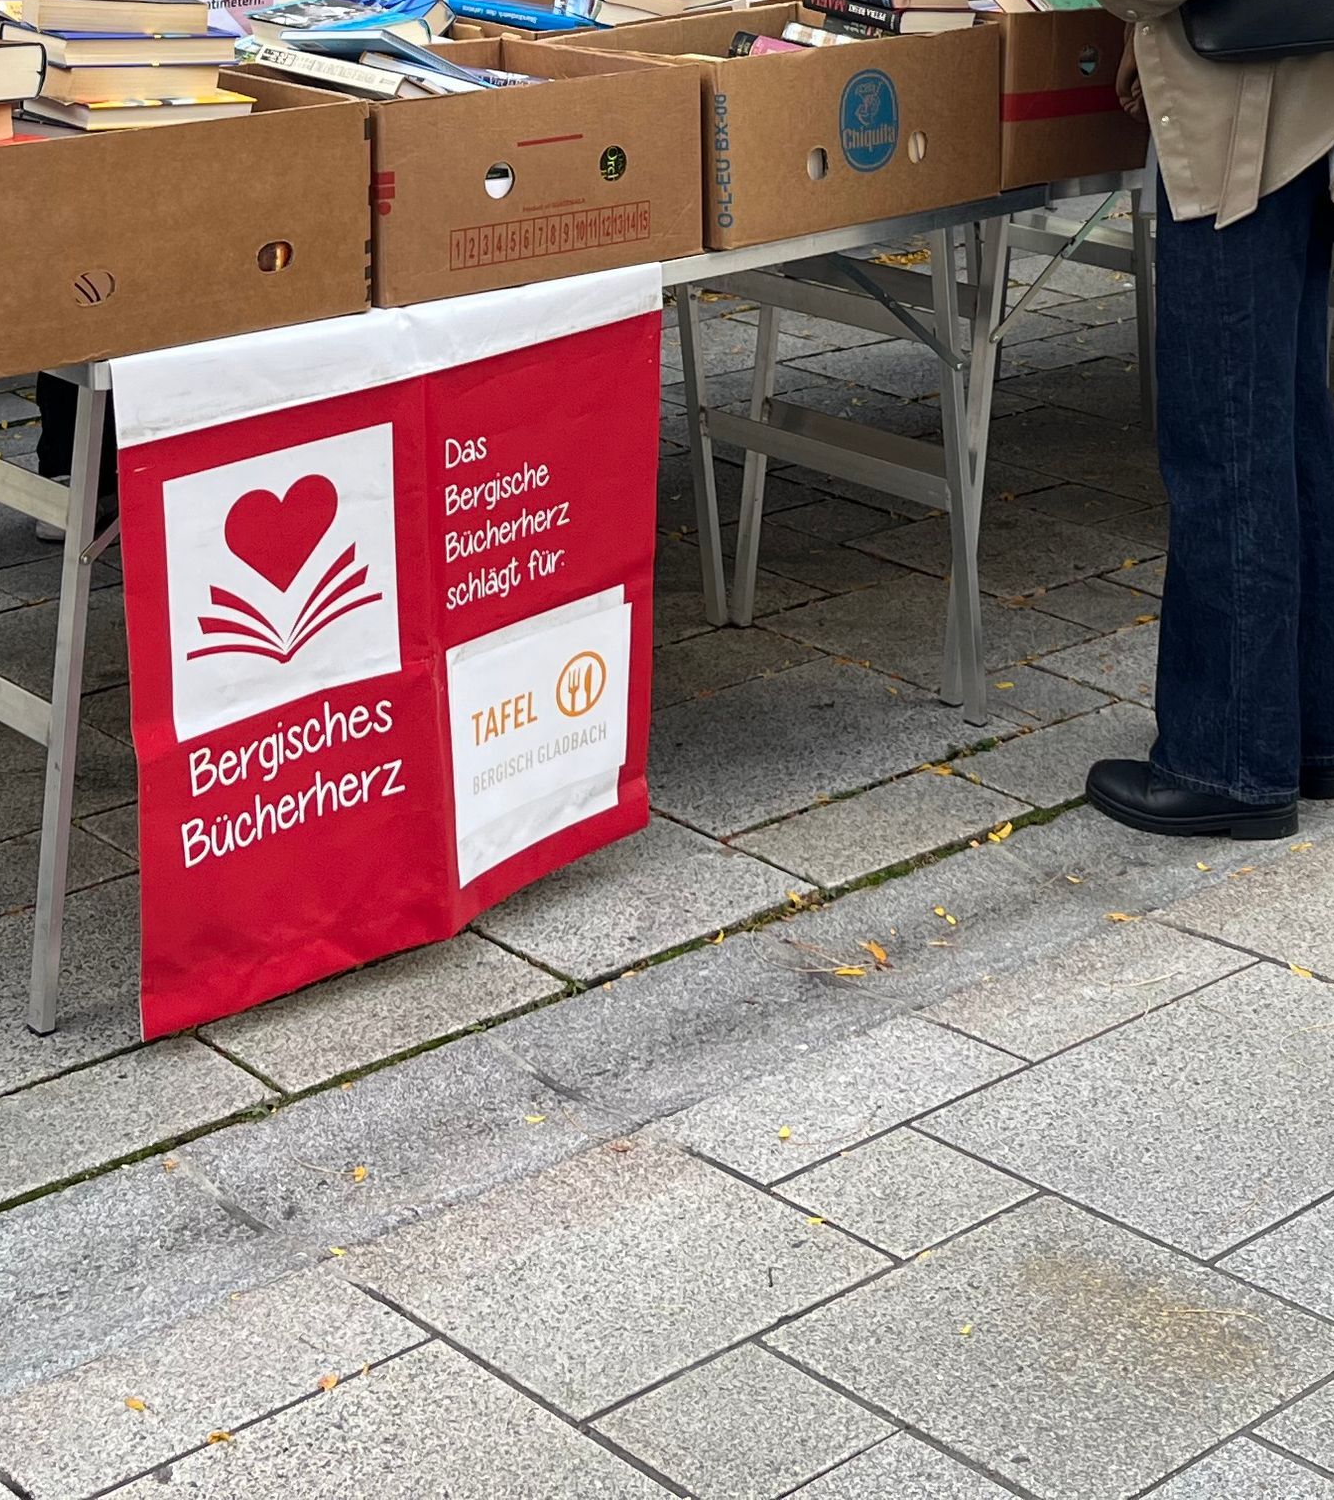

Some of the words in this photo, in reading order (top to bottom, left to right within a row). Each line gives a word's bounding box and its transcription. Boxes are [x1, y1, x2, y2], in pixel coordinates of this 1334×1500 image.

[714, 92, 731, 152] BX-06
[842, 123, 897, 153] Chiquita
[716, 158, 734, 229] O-L-EU
[455, 239, 461, 261] 1
[468, 237, 476, 260] 2
[482, 235, 490, 257] 3
[495, 233, 503, 255] 4
[509, 230, 517, 253] 5
[523, 228, 530, 250] 6
[537, 226, 544, 248] 7
[550, 224, 557, 246] 8
[563, 222, 570, 244] 9
[575, 219, 586, 242] 10
[588, 217, 598, 239] 11
[601, 215, 611, 238] 12
[614, 213, 625, 236] 13
[626, 211, 637, 234] 14
[638, 209, 649, 232] 15
[445, 435, 487, 469] Das
[445, 461, 550, 516] Bergische
[445, 501, 571, 563] Bücherherz
[446, 556, 521, 610] schlägt
[527, 548, 565, 581] für:
[189, 699, 393, 798] Bergisches
[471, 691, 538, 747] TAFEL
[472, 748, 534, 796] BERGISCH
[537, 720, 608, 764] GLADBACH
[181, 758, 406, 869] Bücherherz
